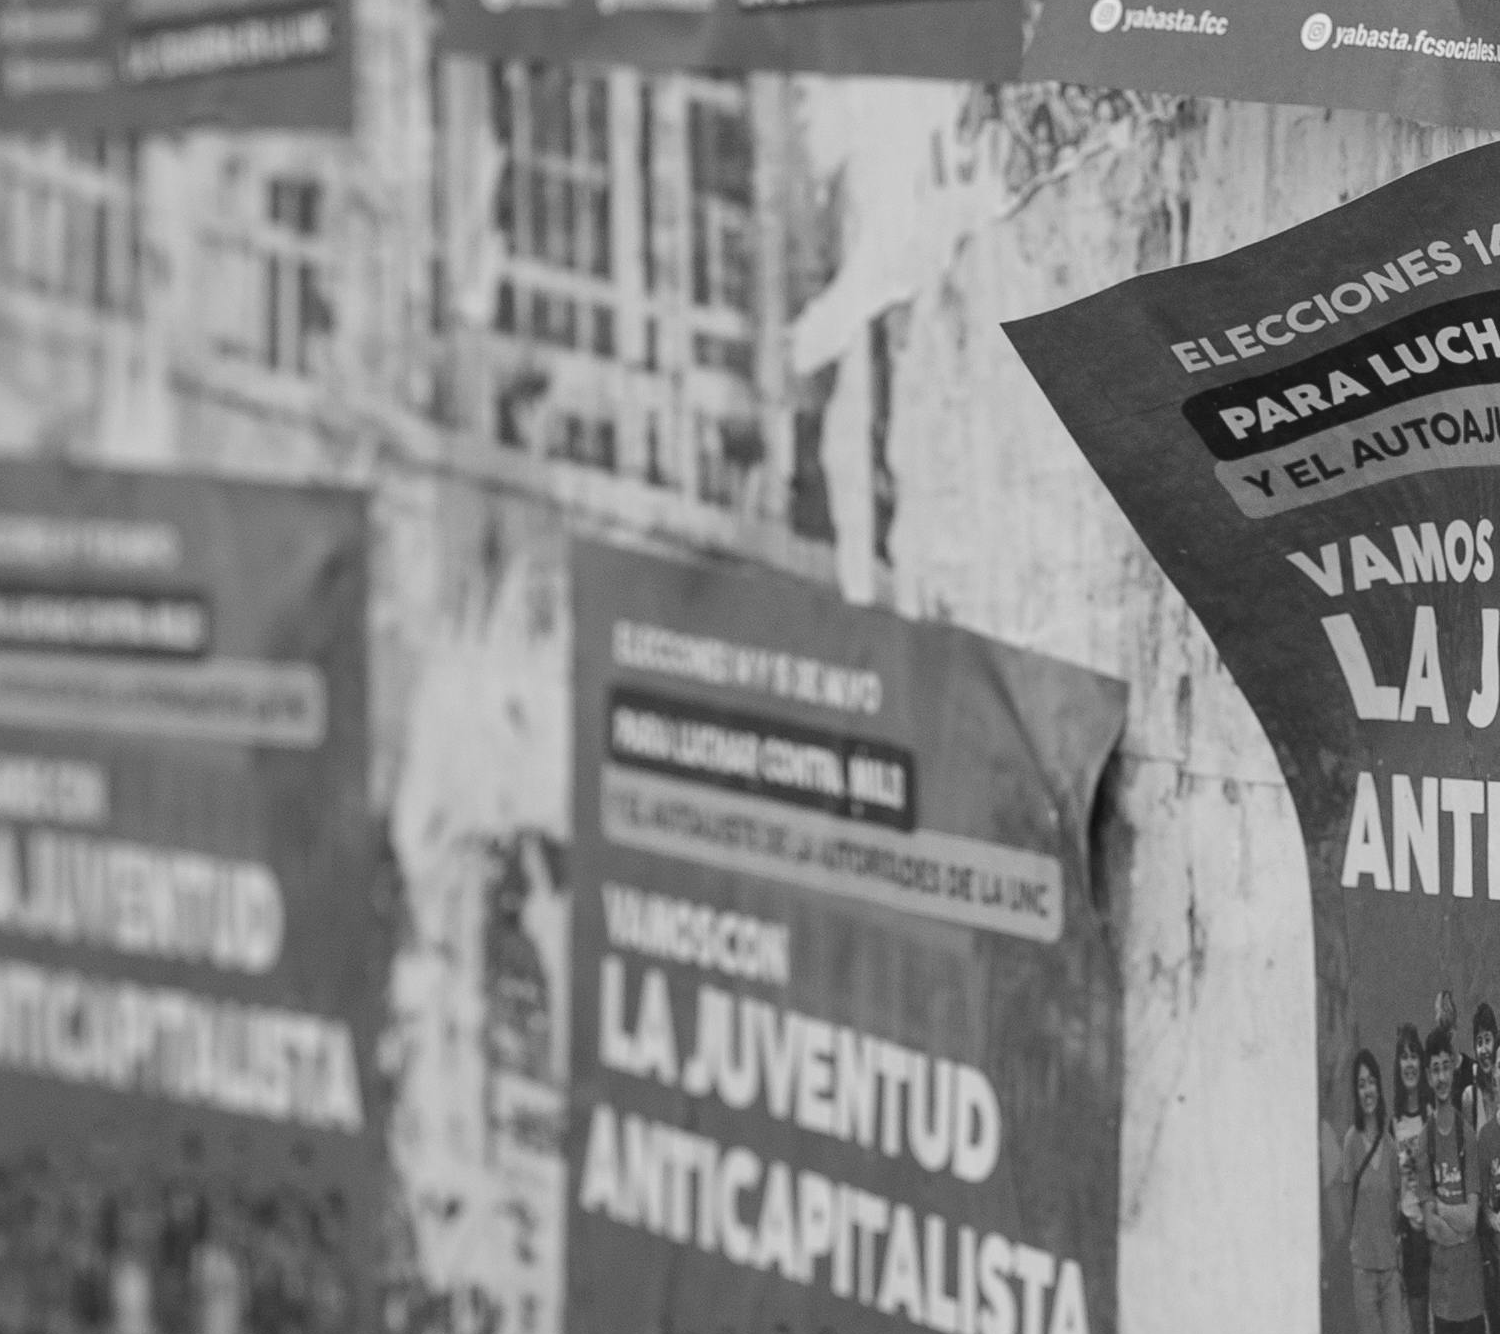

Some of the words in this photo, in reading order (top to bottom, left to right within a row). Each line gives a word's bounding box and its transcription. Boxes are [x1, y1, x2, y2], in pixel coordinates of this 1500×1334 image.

[1122, 6, 1228, 35] yabasta.fcc
[1170, 240, 1463, 376] ELECCIONES
[1219, 371, 1369, 442] PARA
[1241, 470, 1277, 499] Y
[1283, 450, 1344, 490] EL
[1286, 519, 1494, 598] VAMOS
[1321, 605, 1449, 725] LA
[600, 954, 679, 1087] LA
[681, 982, 1002, 1183] JUVENTUD
